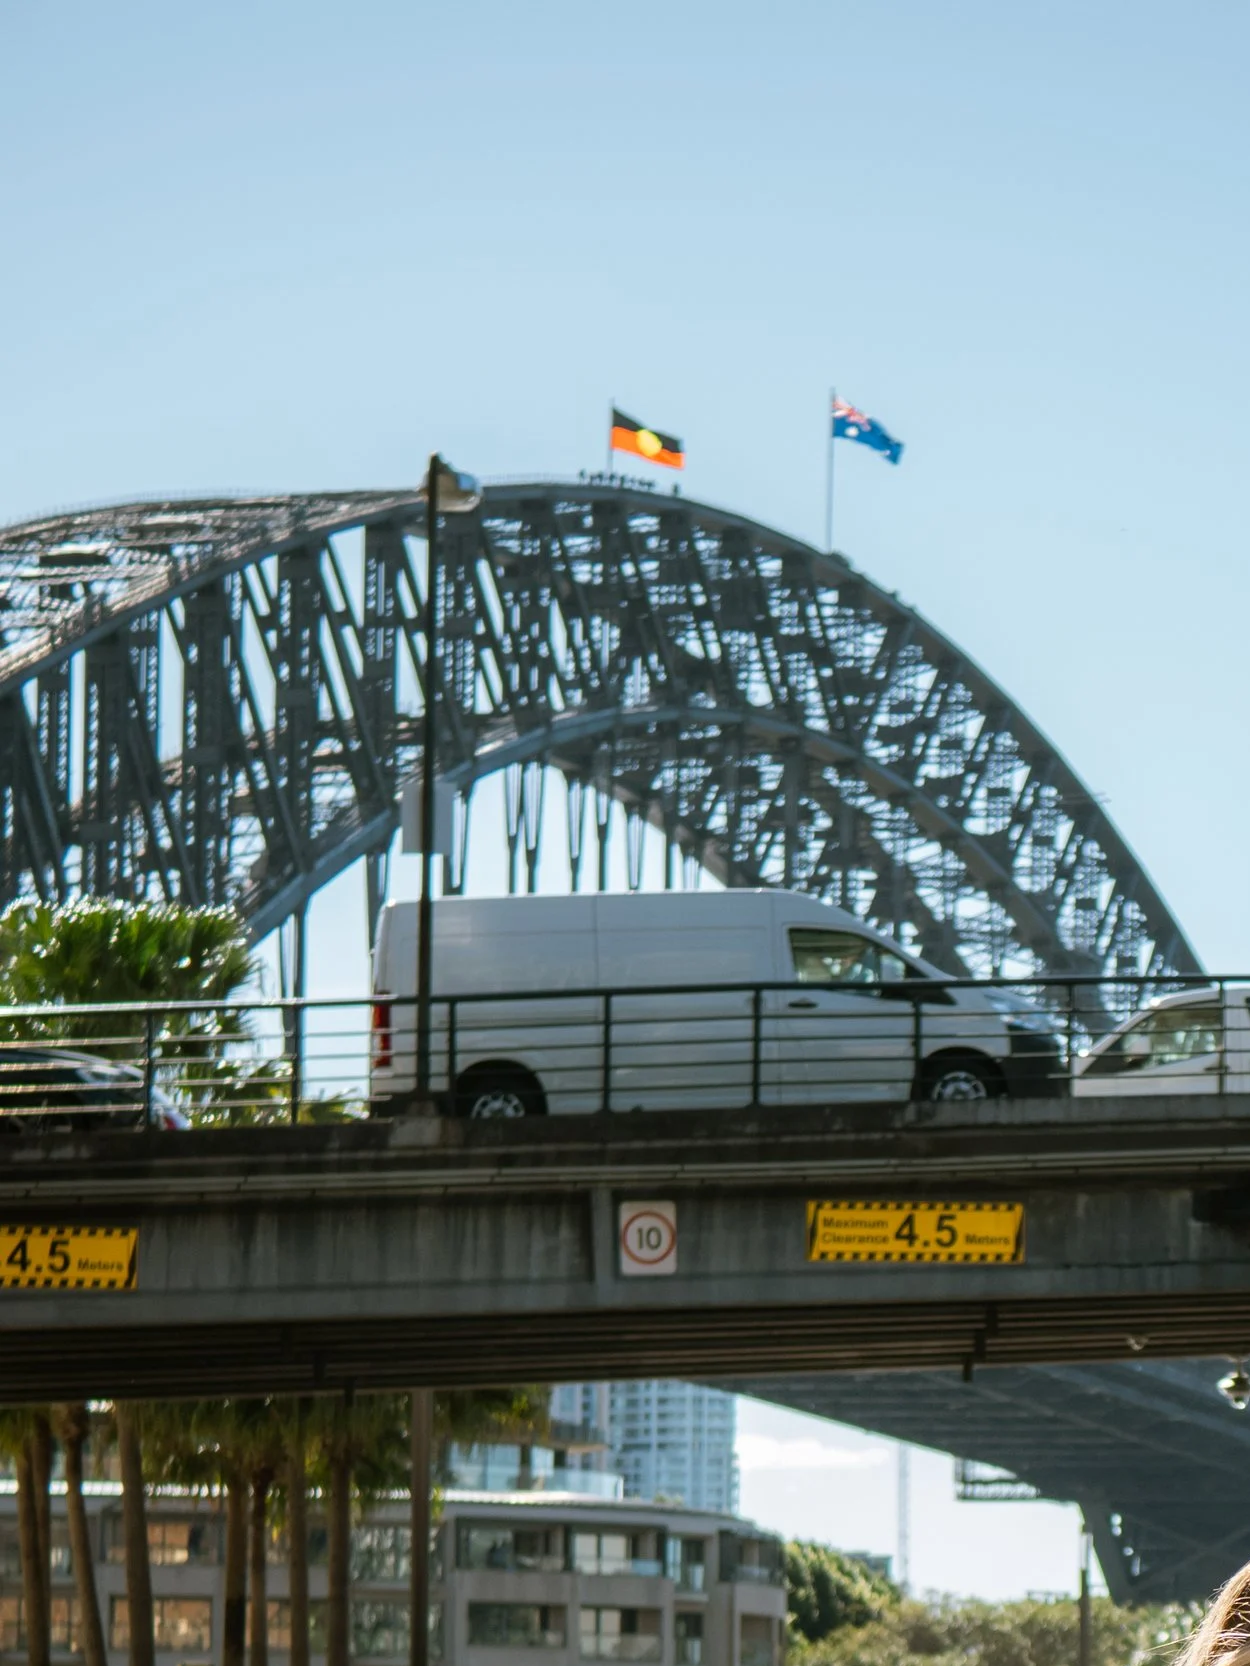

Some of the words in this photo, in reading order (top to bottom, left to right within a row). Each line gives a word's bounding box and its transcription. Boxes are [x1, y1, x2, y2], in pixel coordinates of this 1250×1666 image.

[822, 1216, 889, 1229] Maximum
[894, 1213, 958, 1248] 4.5
[637, 1226, 662, 1250] 10
[822, 1231, 889, 1244] Clearance
[6, 1236, 71, 1273] 4.5
